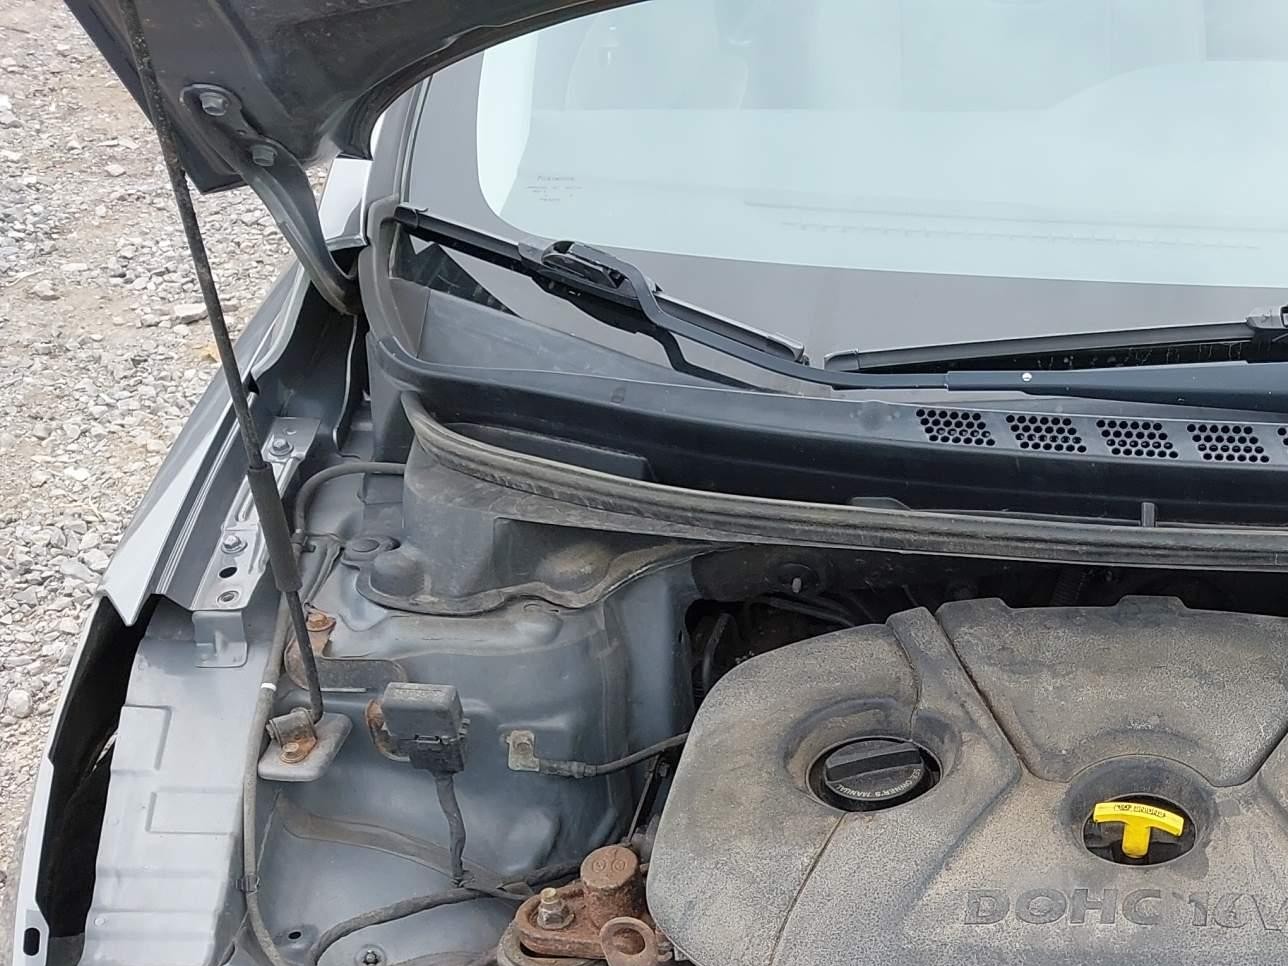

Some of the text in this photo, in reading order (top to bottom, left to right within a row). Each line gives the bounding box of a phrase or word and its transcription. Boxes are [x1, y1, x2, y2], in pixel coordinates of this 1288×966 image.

[835, 783, 872, 798] MANUAL
[874, 779, 913, 797] OWNER'S
[963, 887, 1163, 926] DOHC
